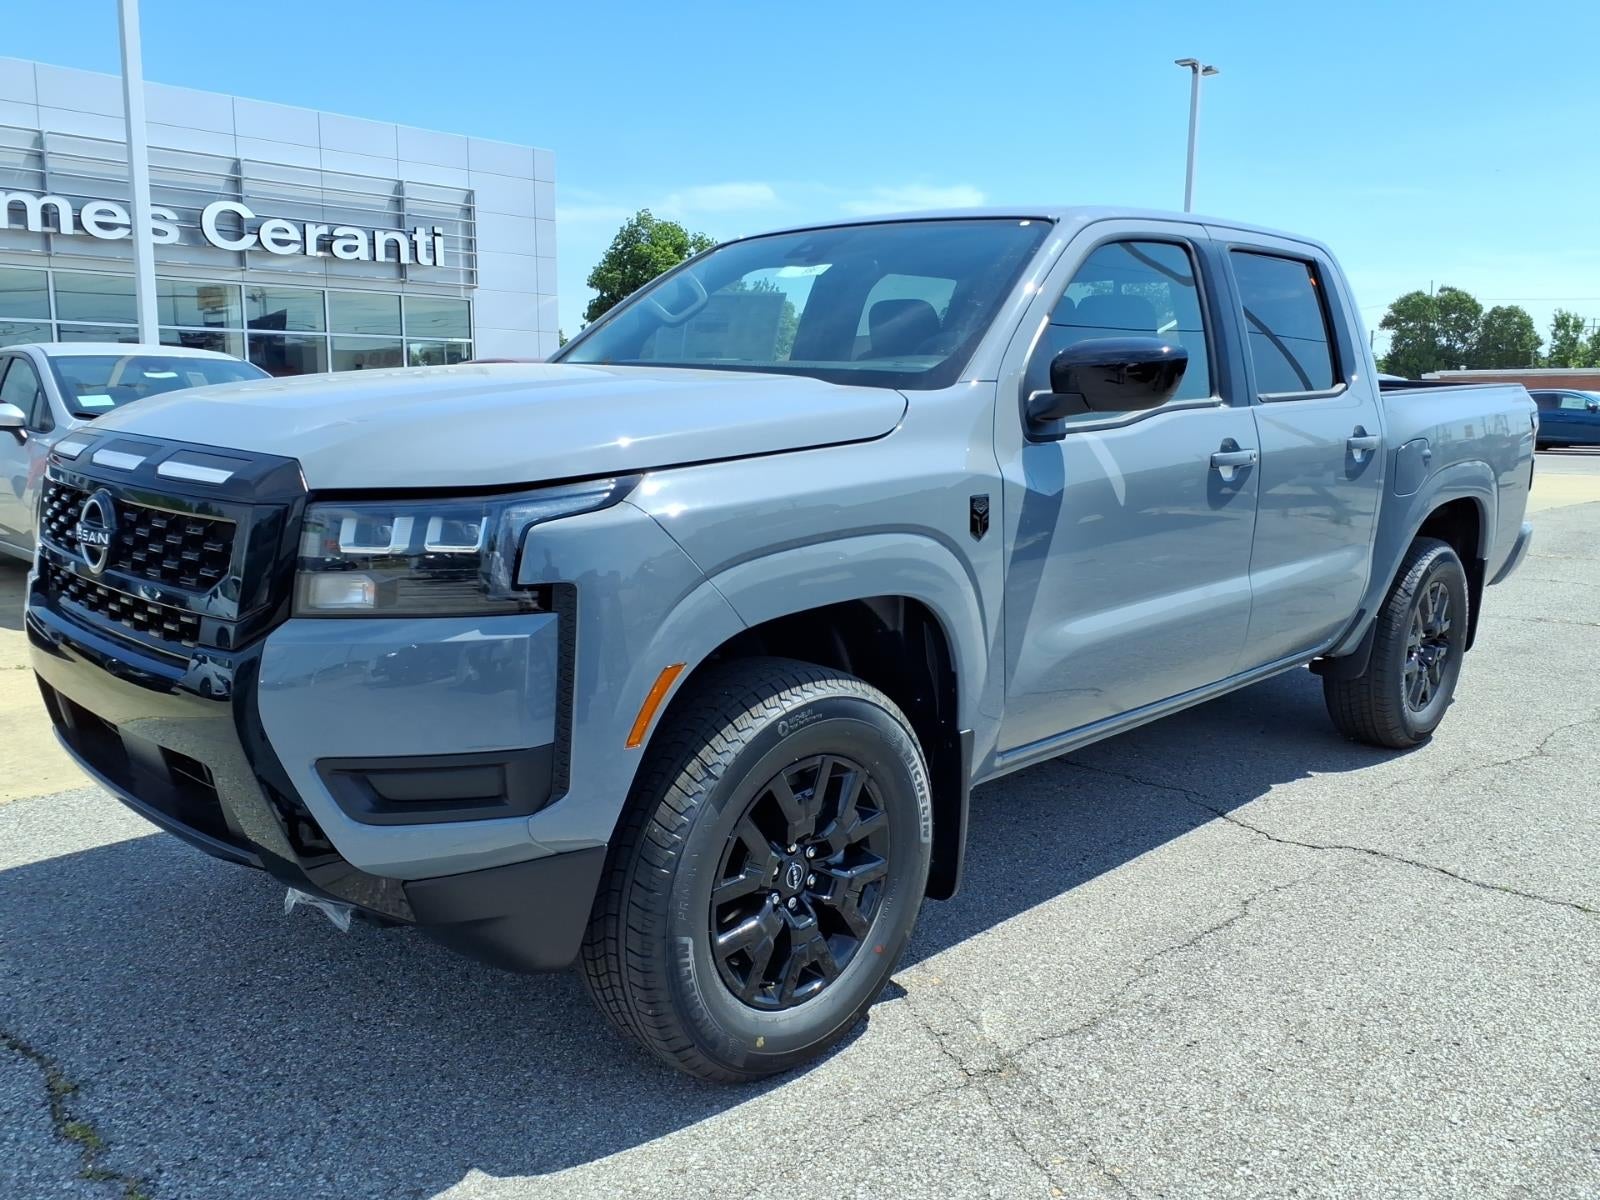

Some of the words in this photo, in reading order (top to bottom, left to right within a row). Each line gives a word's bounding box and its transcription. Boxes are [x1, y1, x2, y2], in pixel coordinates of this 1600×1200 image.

[201, 200, 445, 266] Ceranti
[77, 523, 109, 545] SSAN
[903, 750, 930, 838] MICHELIN
